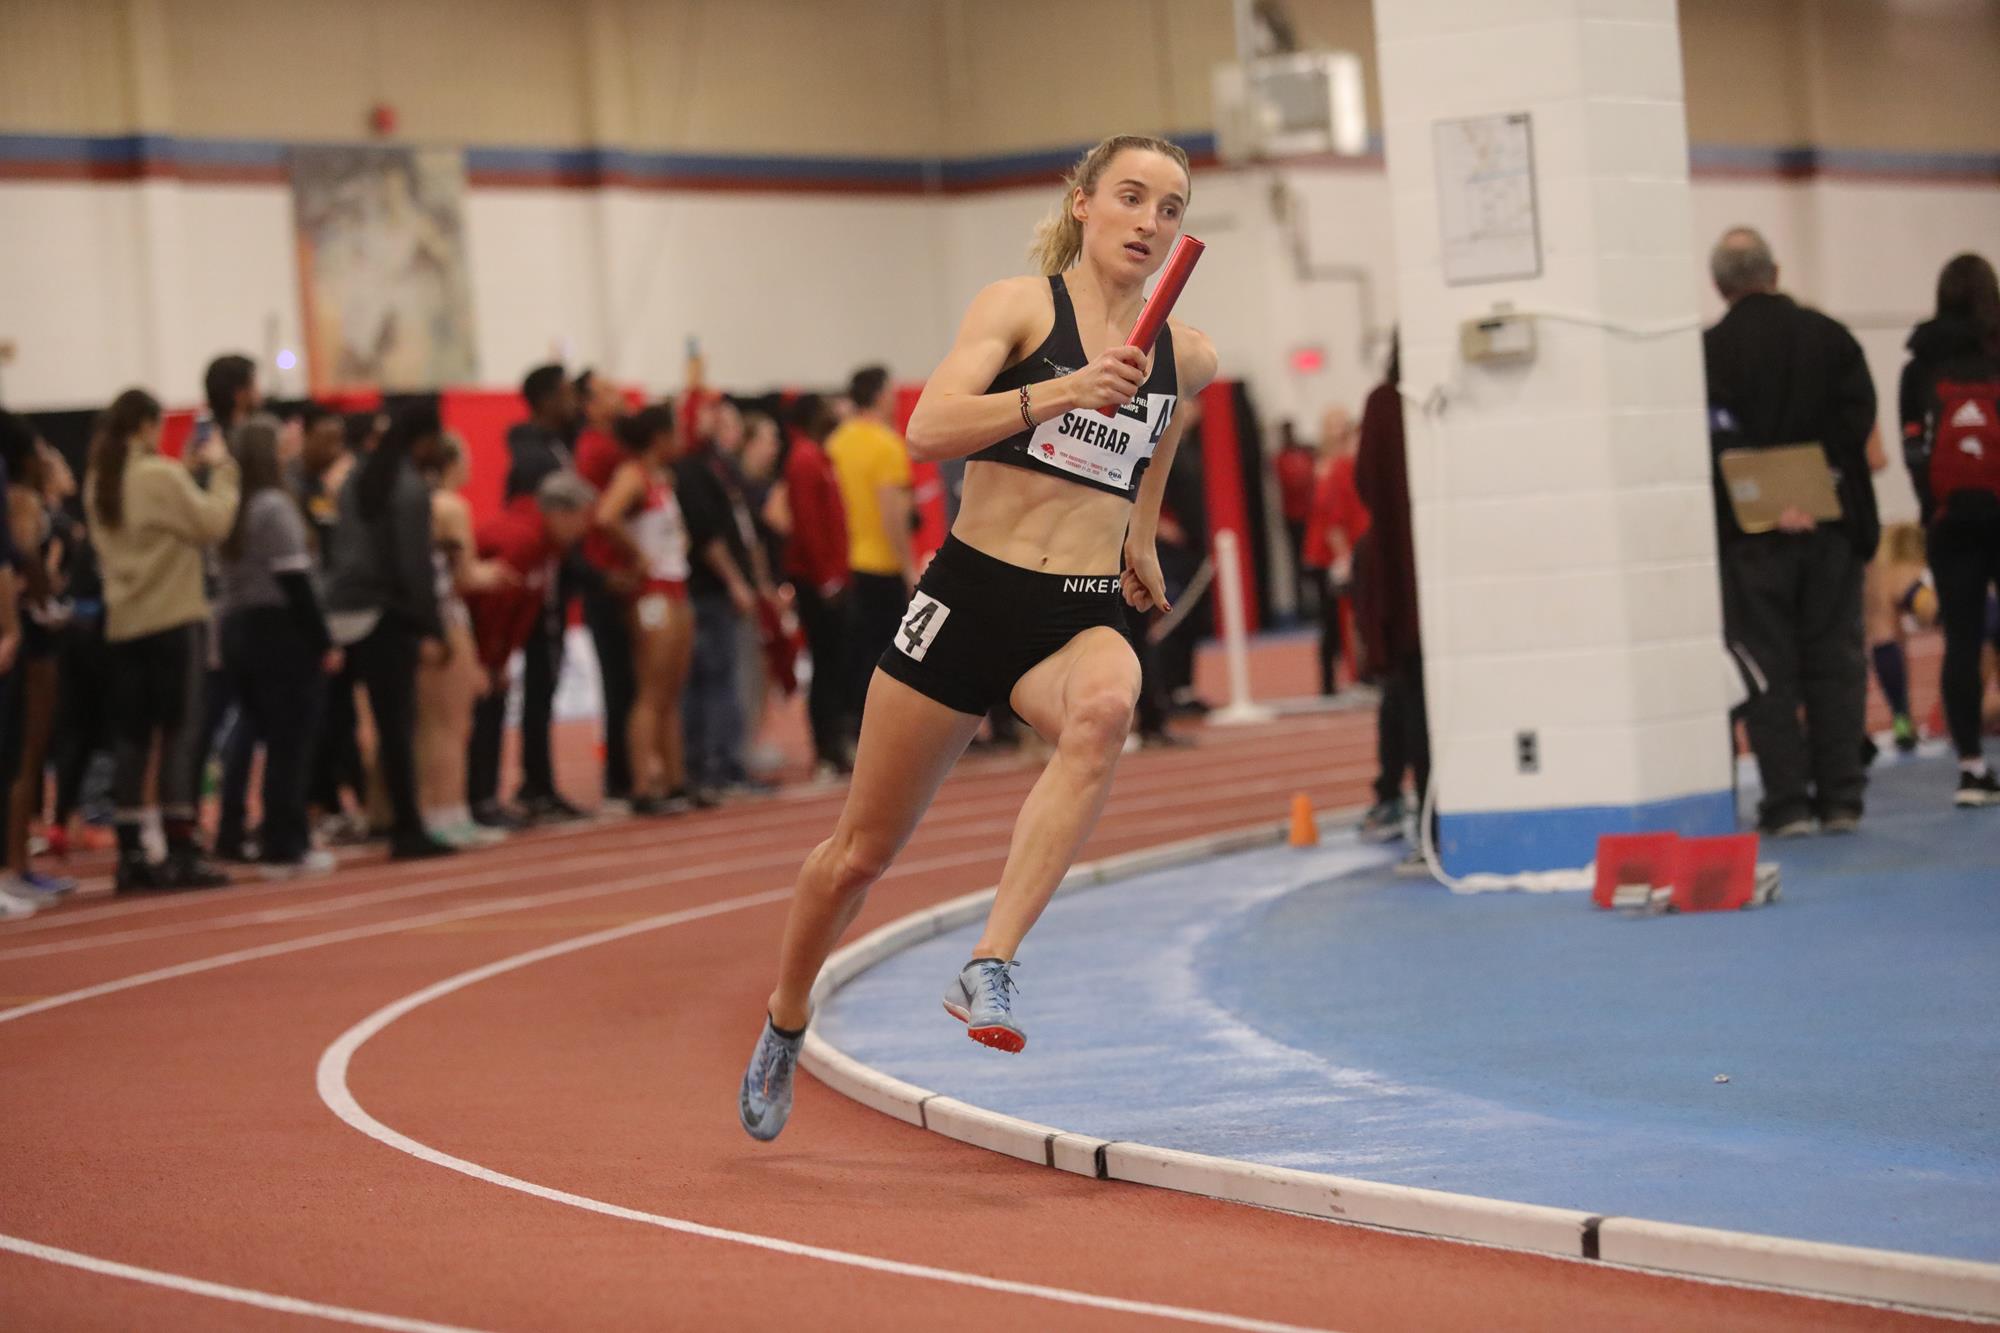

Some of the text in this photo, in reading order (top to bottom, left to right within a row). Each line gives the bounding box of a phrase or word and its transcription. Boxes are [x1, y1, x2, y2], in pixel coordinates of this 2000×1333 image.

[1058, 413, 1131, 455] SHERAR
[1149, 399, 1170, 443] 4
[1063, 578, 1109, 593] NIKE
[903, 601, 939, 654] 4
